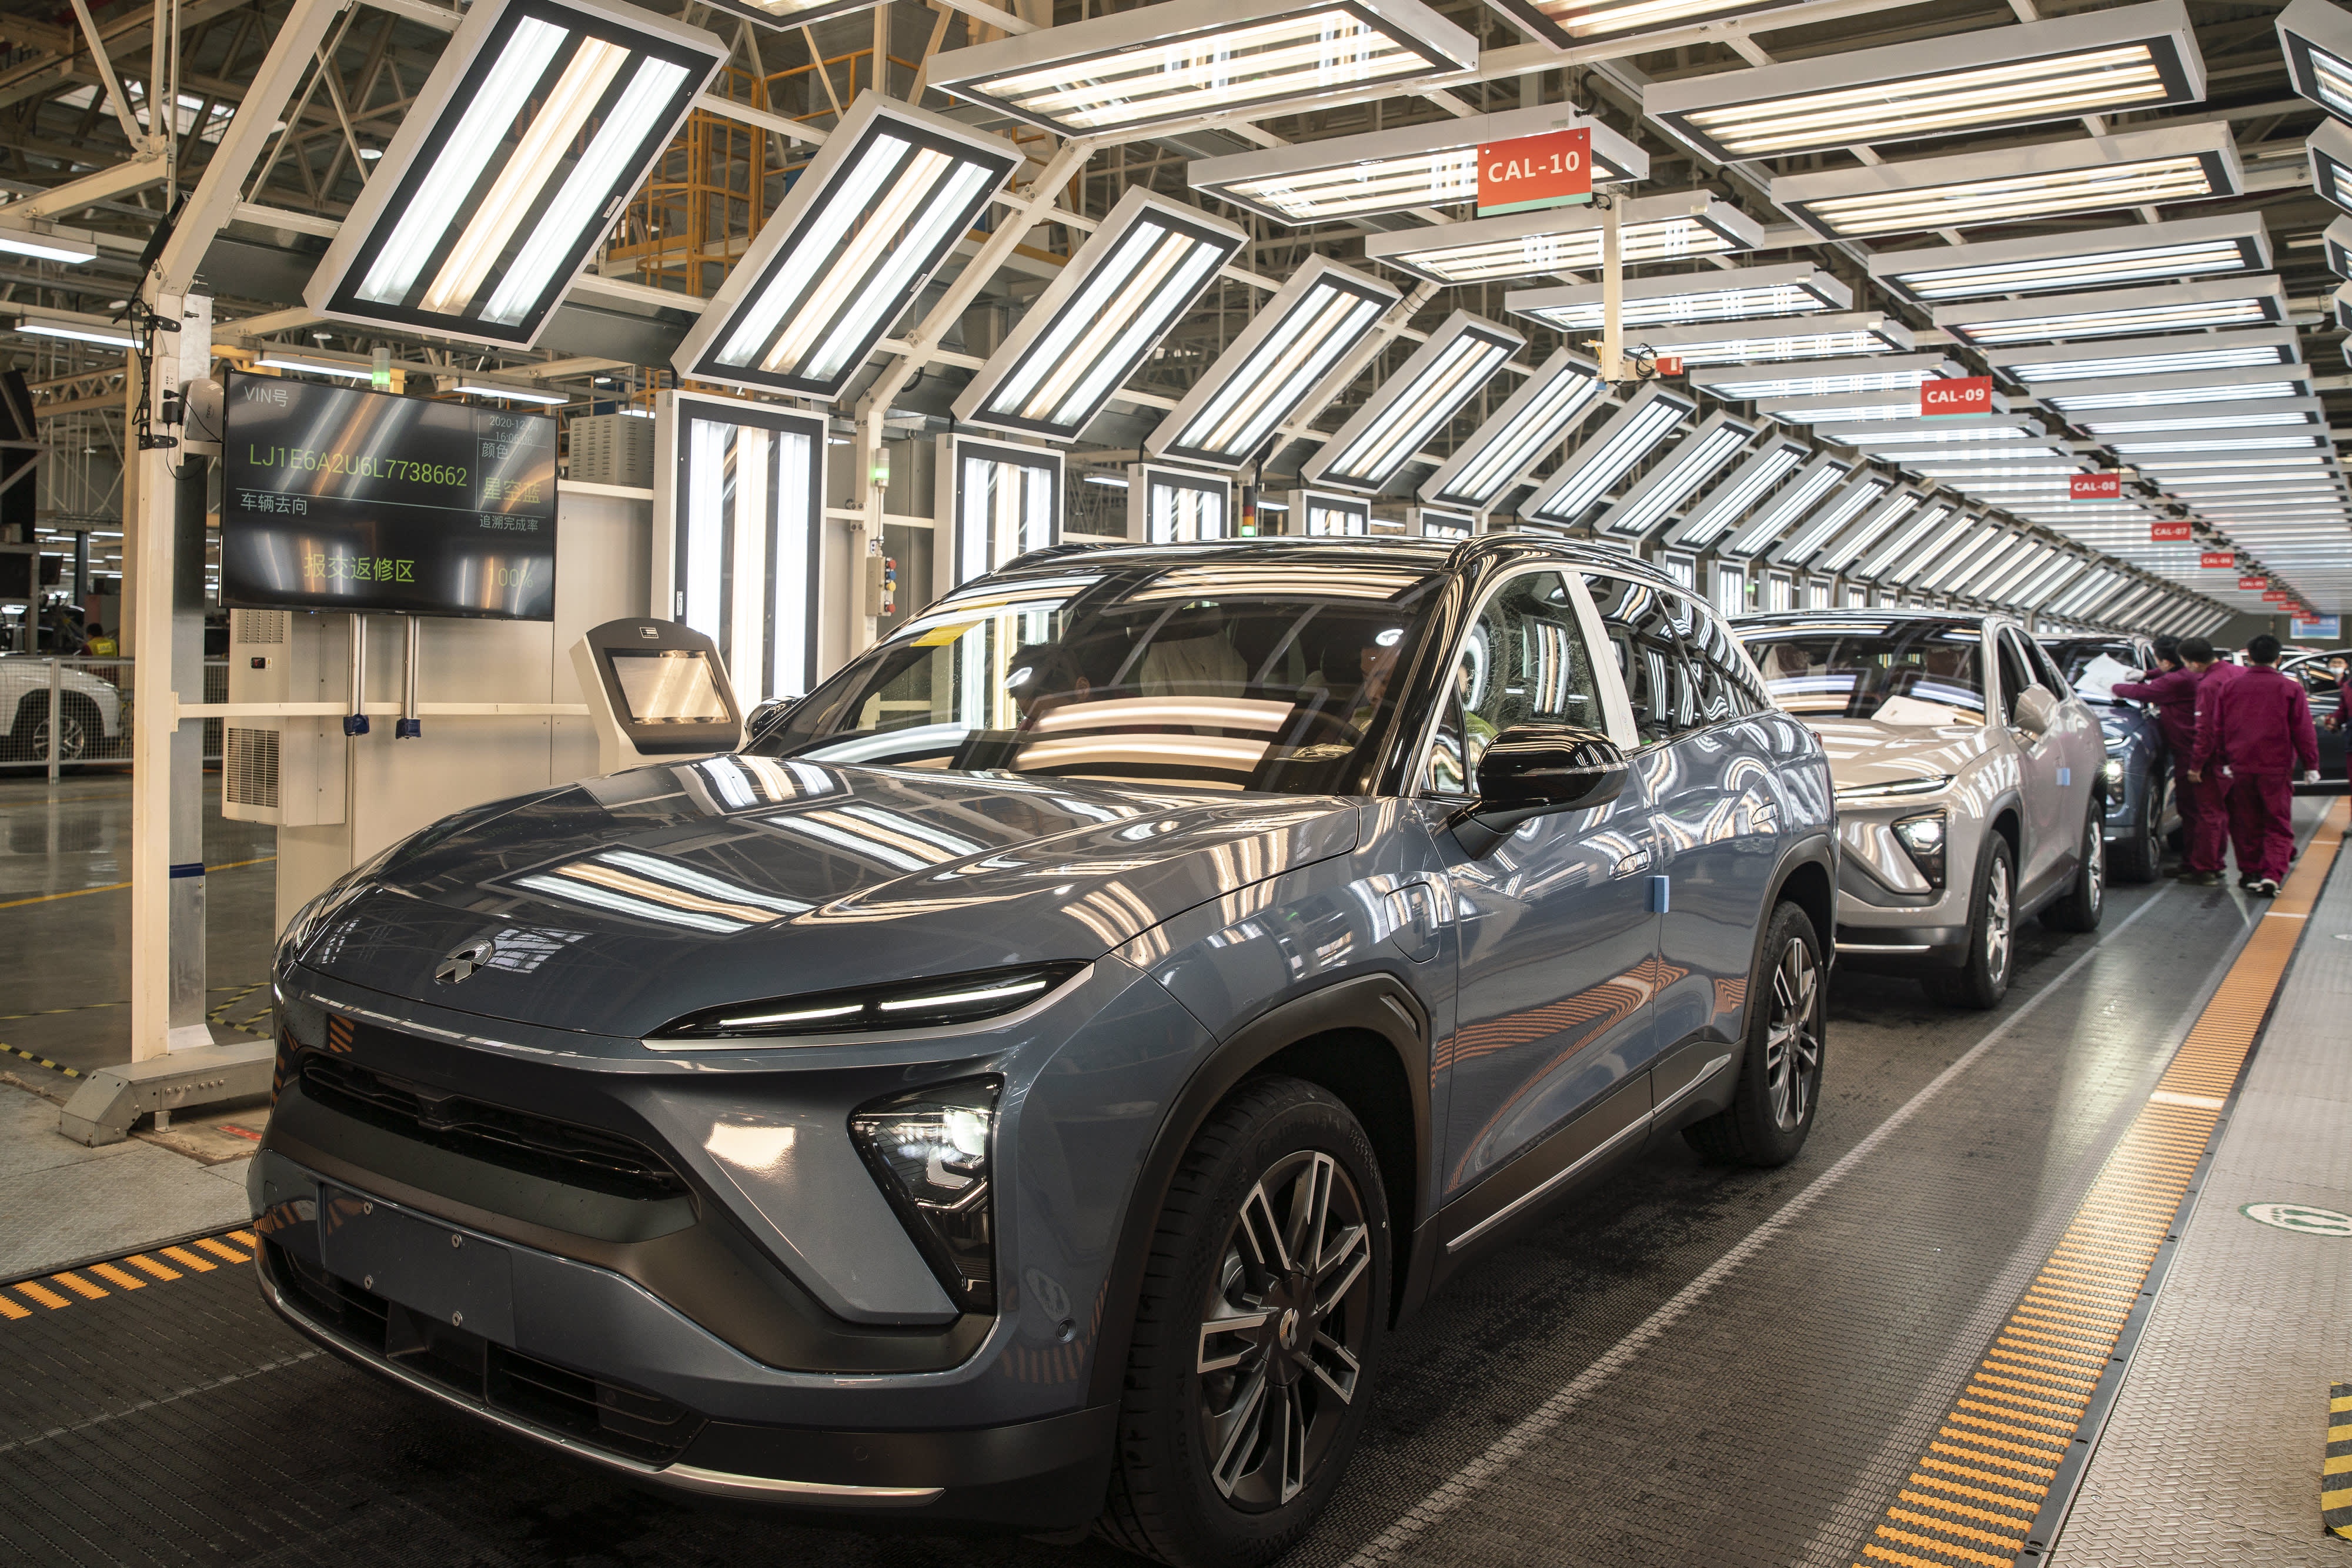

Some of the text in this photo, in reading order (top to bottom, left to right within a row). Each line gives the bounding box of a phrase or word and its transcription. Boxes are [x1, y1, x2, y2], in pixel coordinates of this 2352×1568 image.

[1488, 151, 1580, 183] CAL-10
[244, 386, 288, 407] VIN号
[1927, 388, 1985, 403] CAL-09
[489, 416, 539, 432] 2020-1204
[482, 442, 509, 459] 颜色
[250, 444, 467, 487] LJ1E6A2U6L7738662
[483, 477, 541, 503] 星空蓝
[2074, 481, 2117, 492] CAL-08
[240, 493, 308, 516] 车辆去向
[480, 514, 539, 532] 追溯完成率
[2154, 527, 2187, 536] CAL-07
[304, 554, 415, 583] 报交返修区
